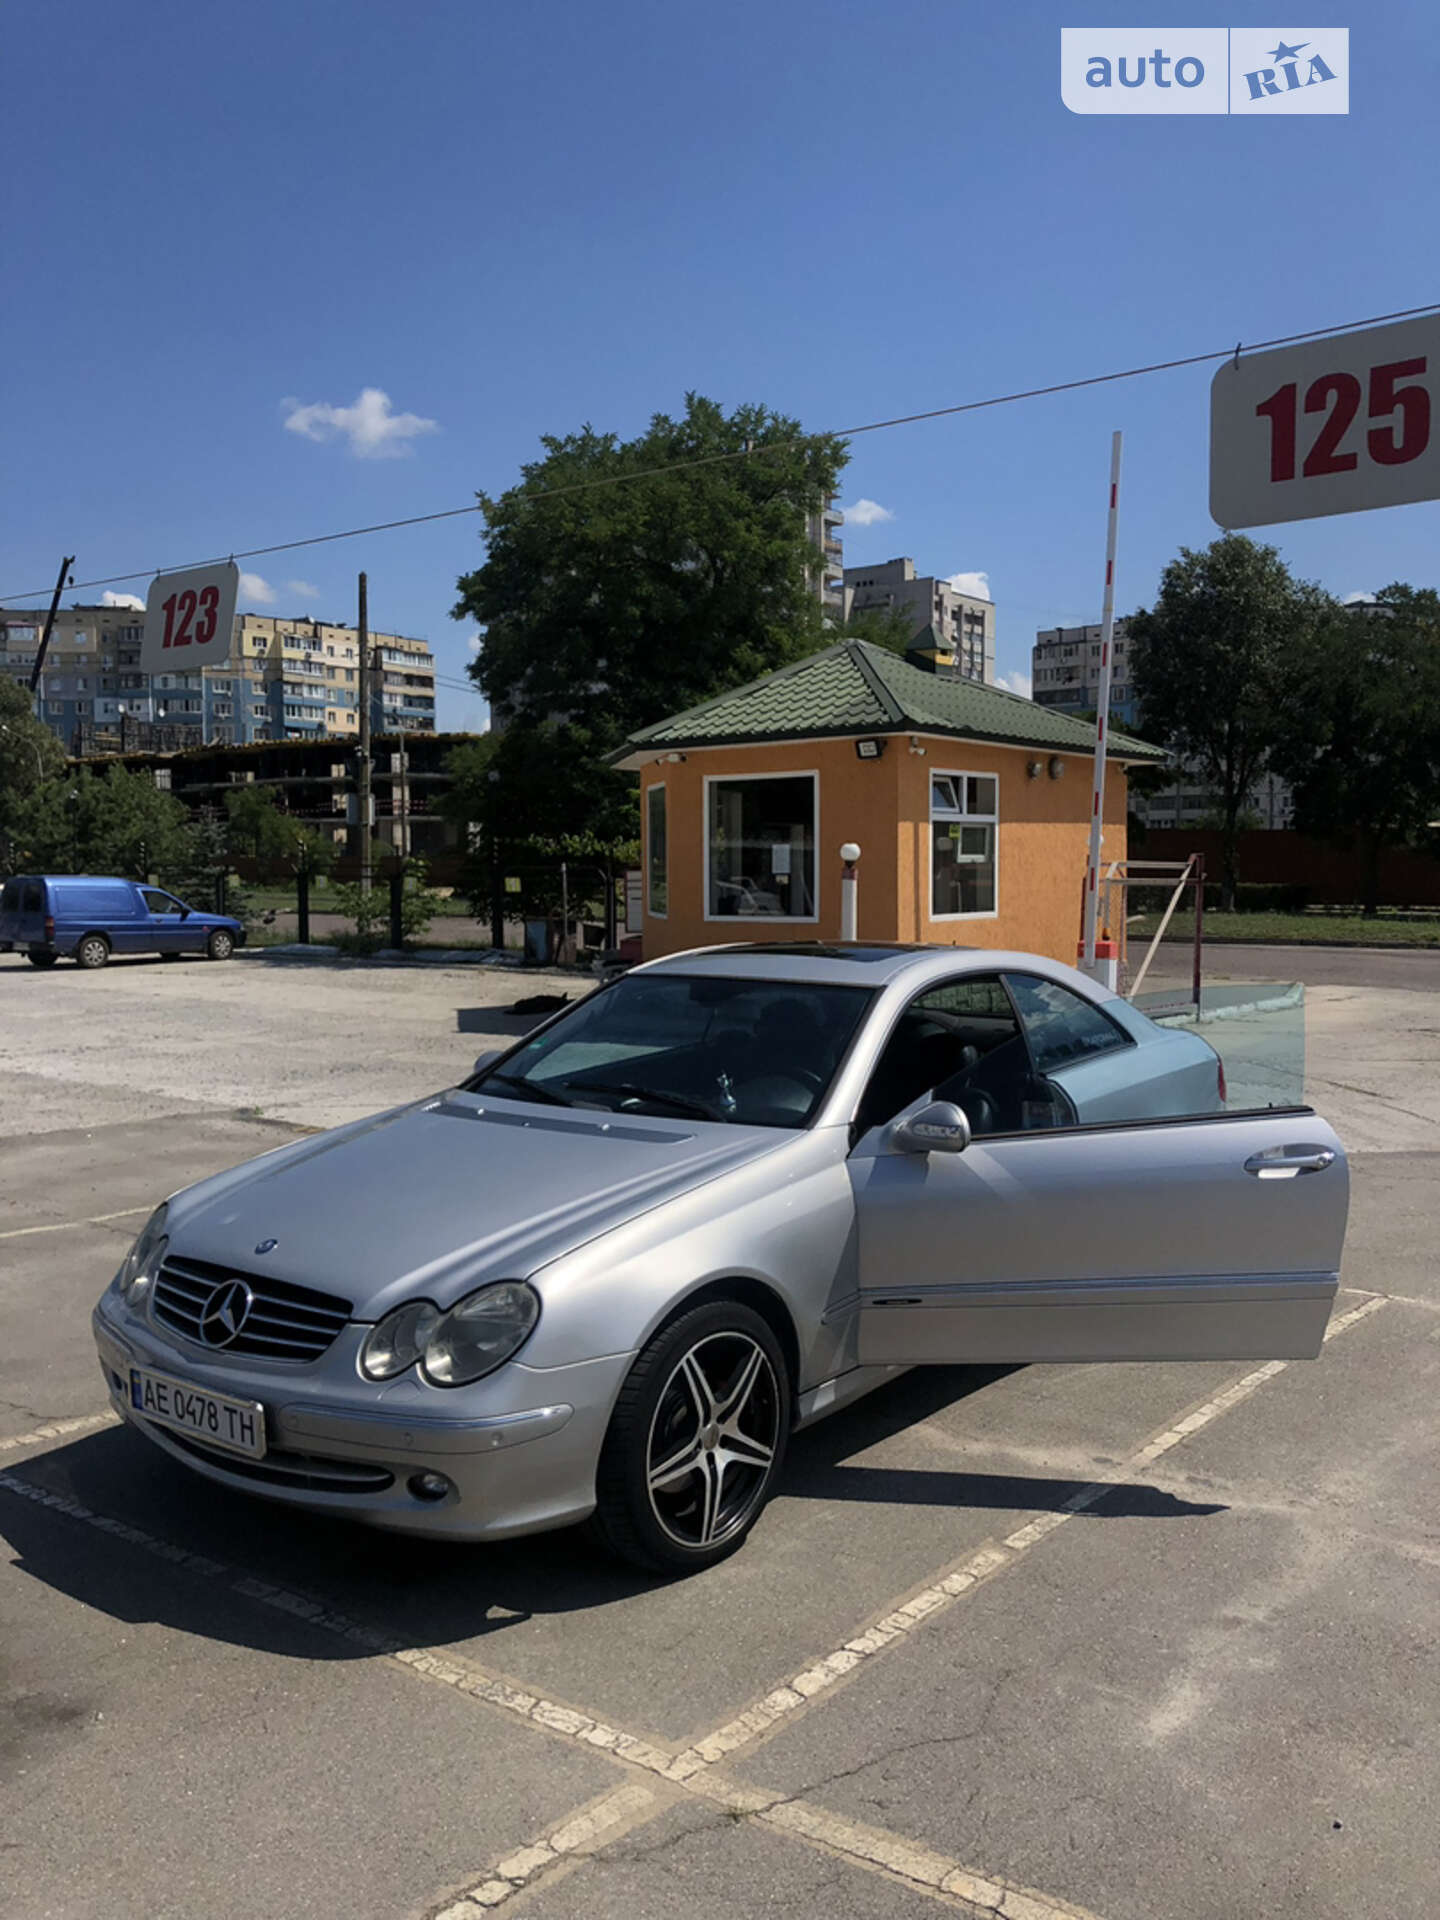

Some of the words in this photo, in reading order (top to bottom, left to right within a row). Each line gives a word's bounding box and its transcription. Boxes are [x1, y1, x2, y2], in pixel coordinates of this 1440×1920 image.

[1256, 356, 1430, 482] 125
[161, 585, 220, 649] 123
[144, 1379, 170, 1415] AE
[174, 1389, 219, 1432] 0478
[223, 1405, 255, 1446] TH
